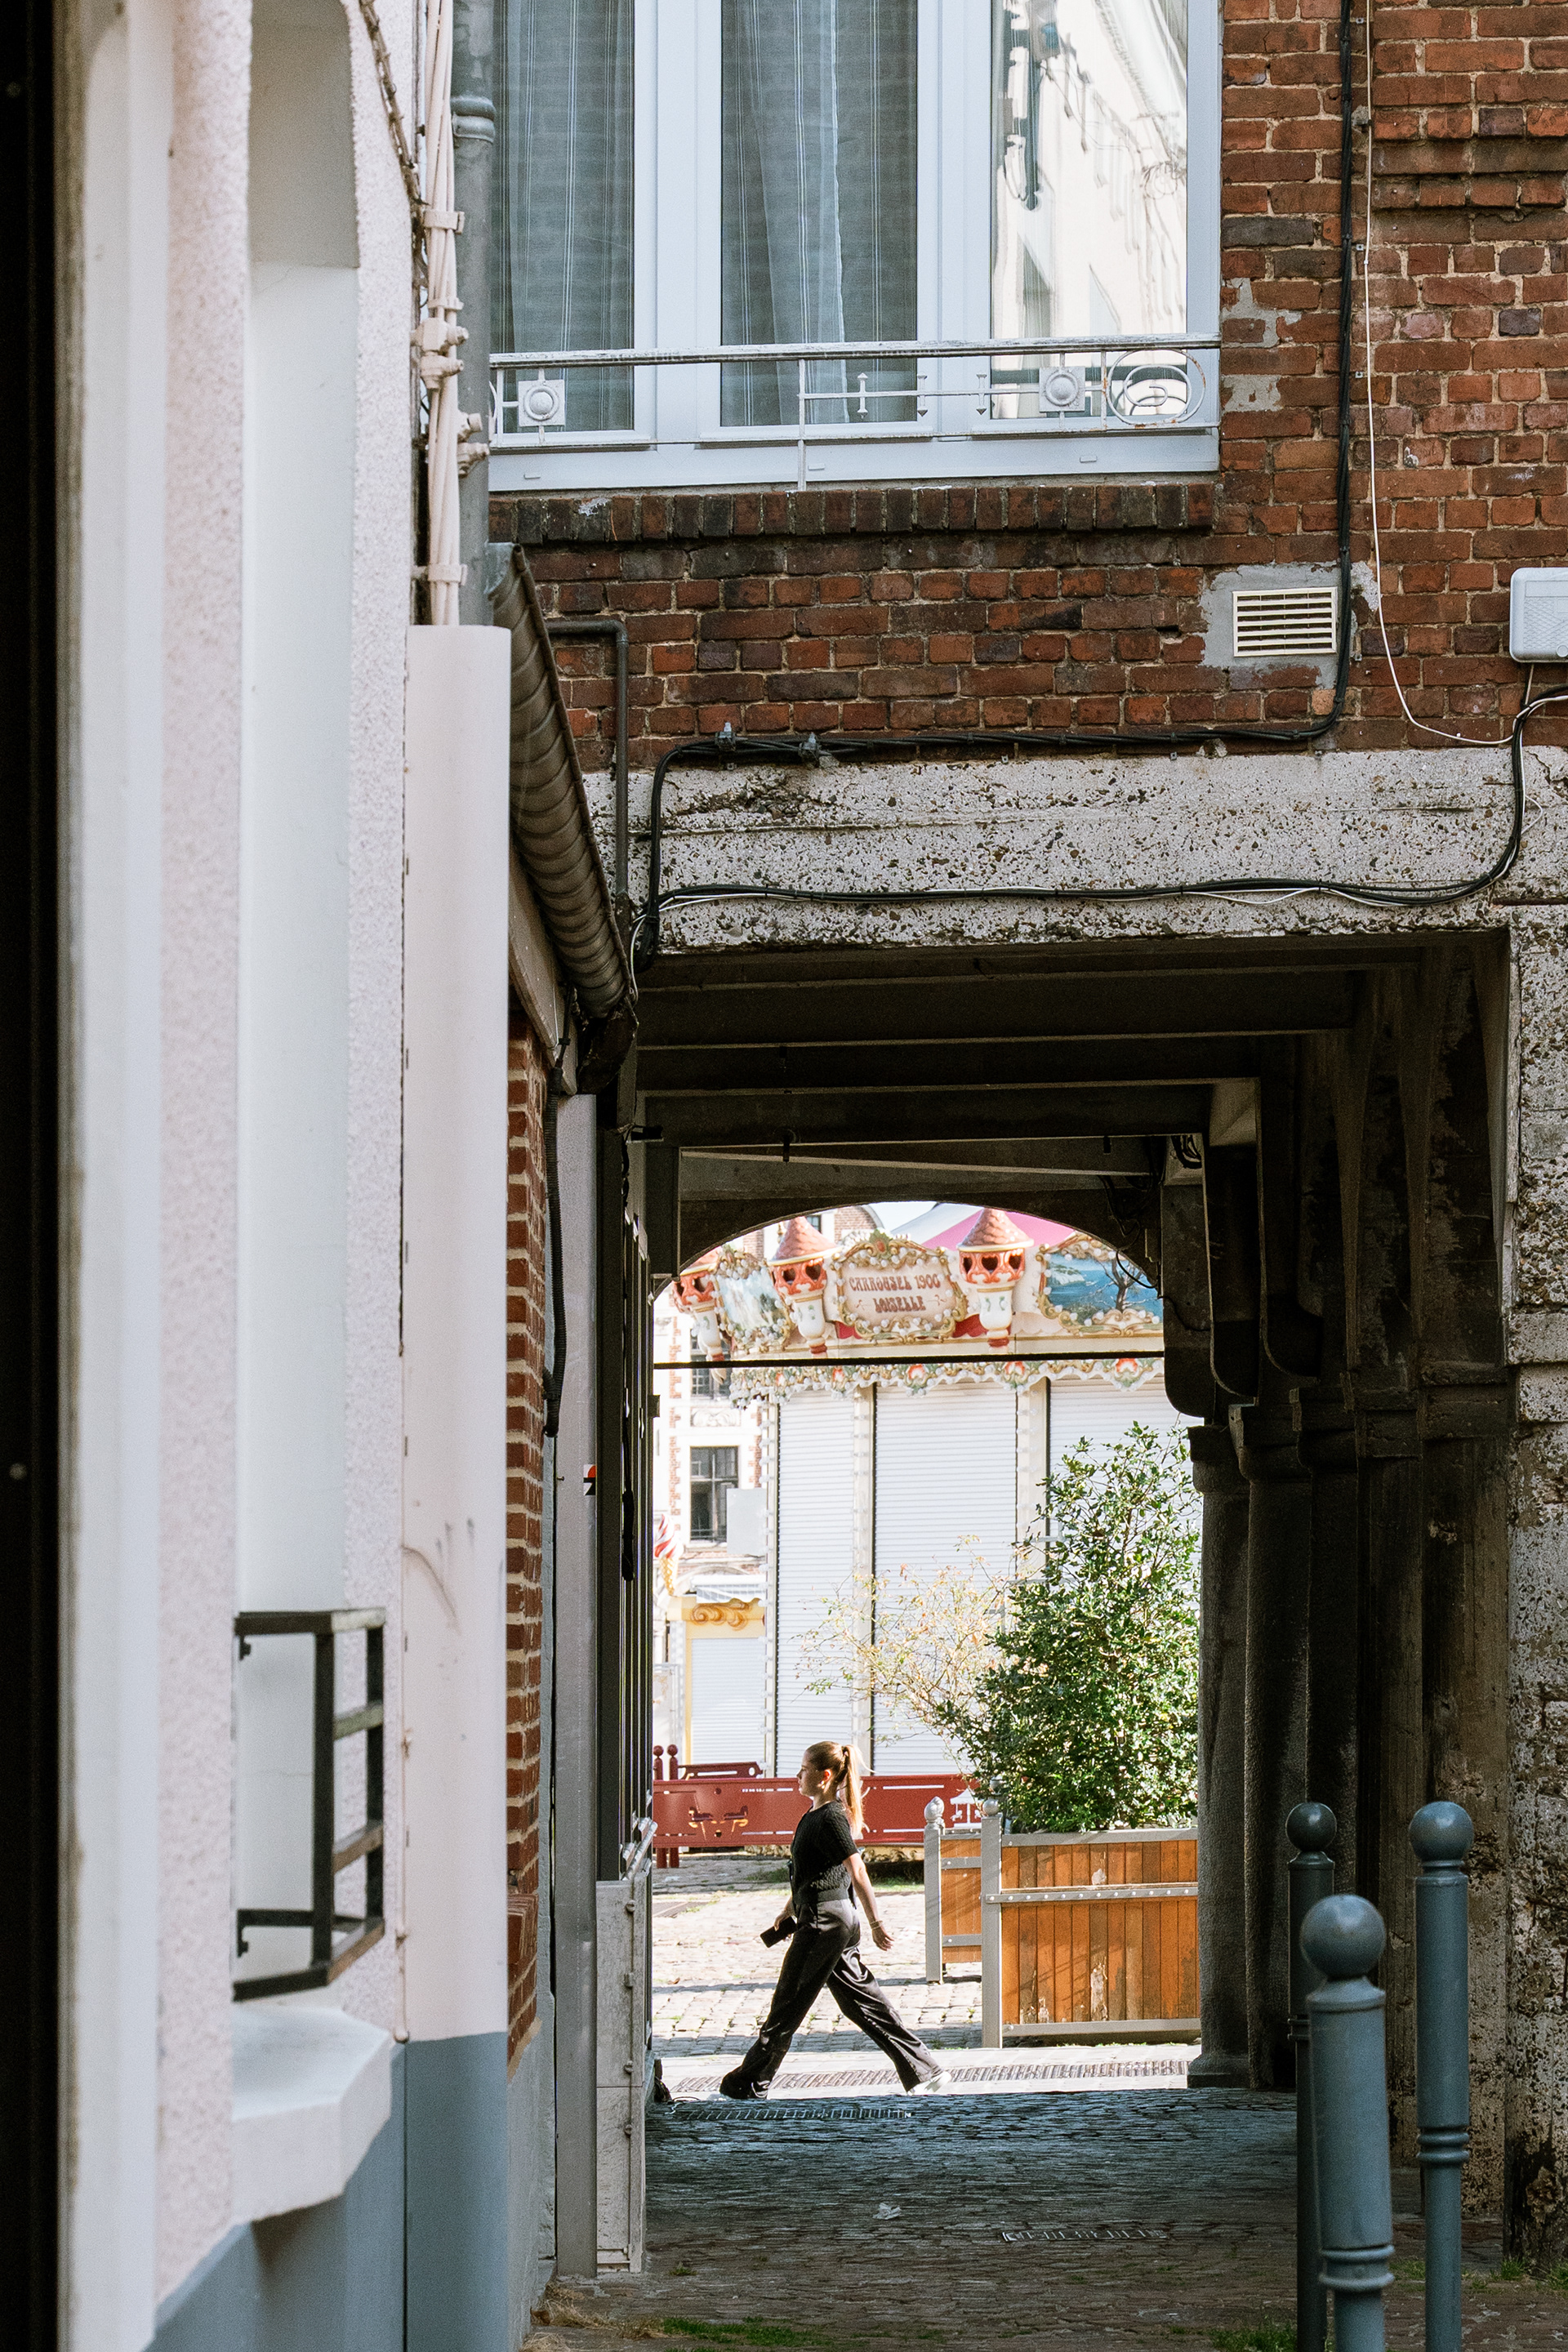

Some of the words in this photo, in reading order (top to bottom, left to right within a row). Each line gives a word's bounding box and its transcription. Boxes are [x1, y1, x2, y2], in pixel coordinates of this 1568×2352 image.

[849, 1276, 912, 1291] CARROUSEL
[914, 1273, 941, 1289] 1900
[873, 1295, 926, 1313] LOISELLE
